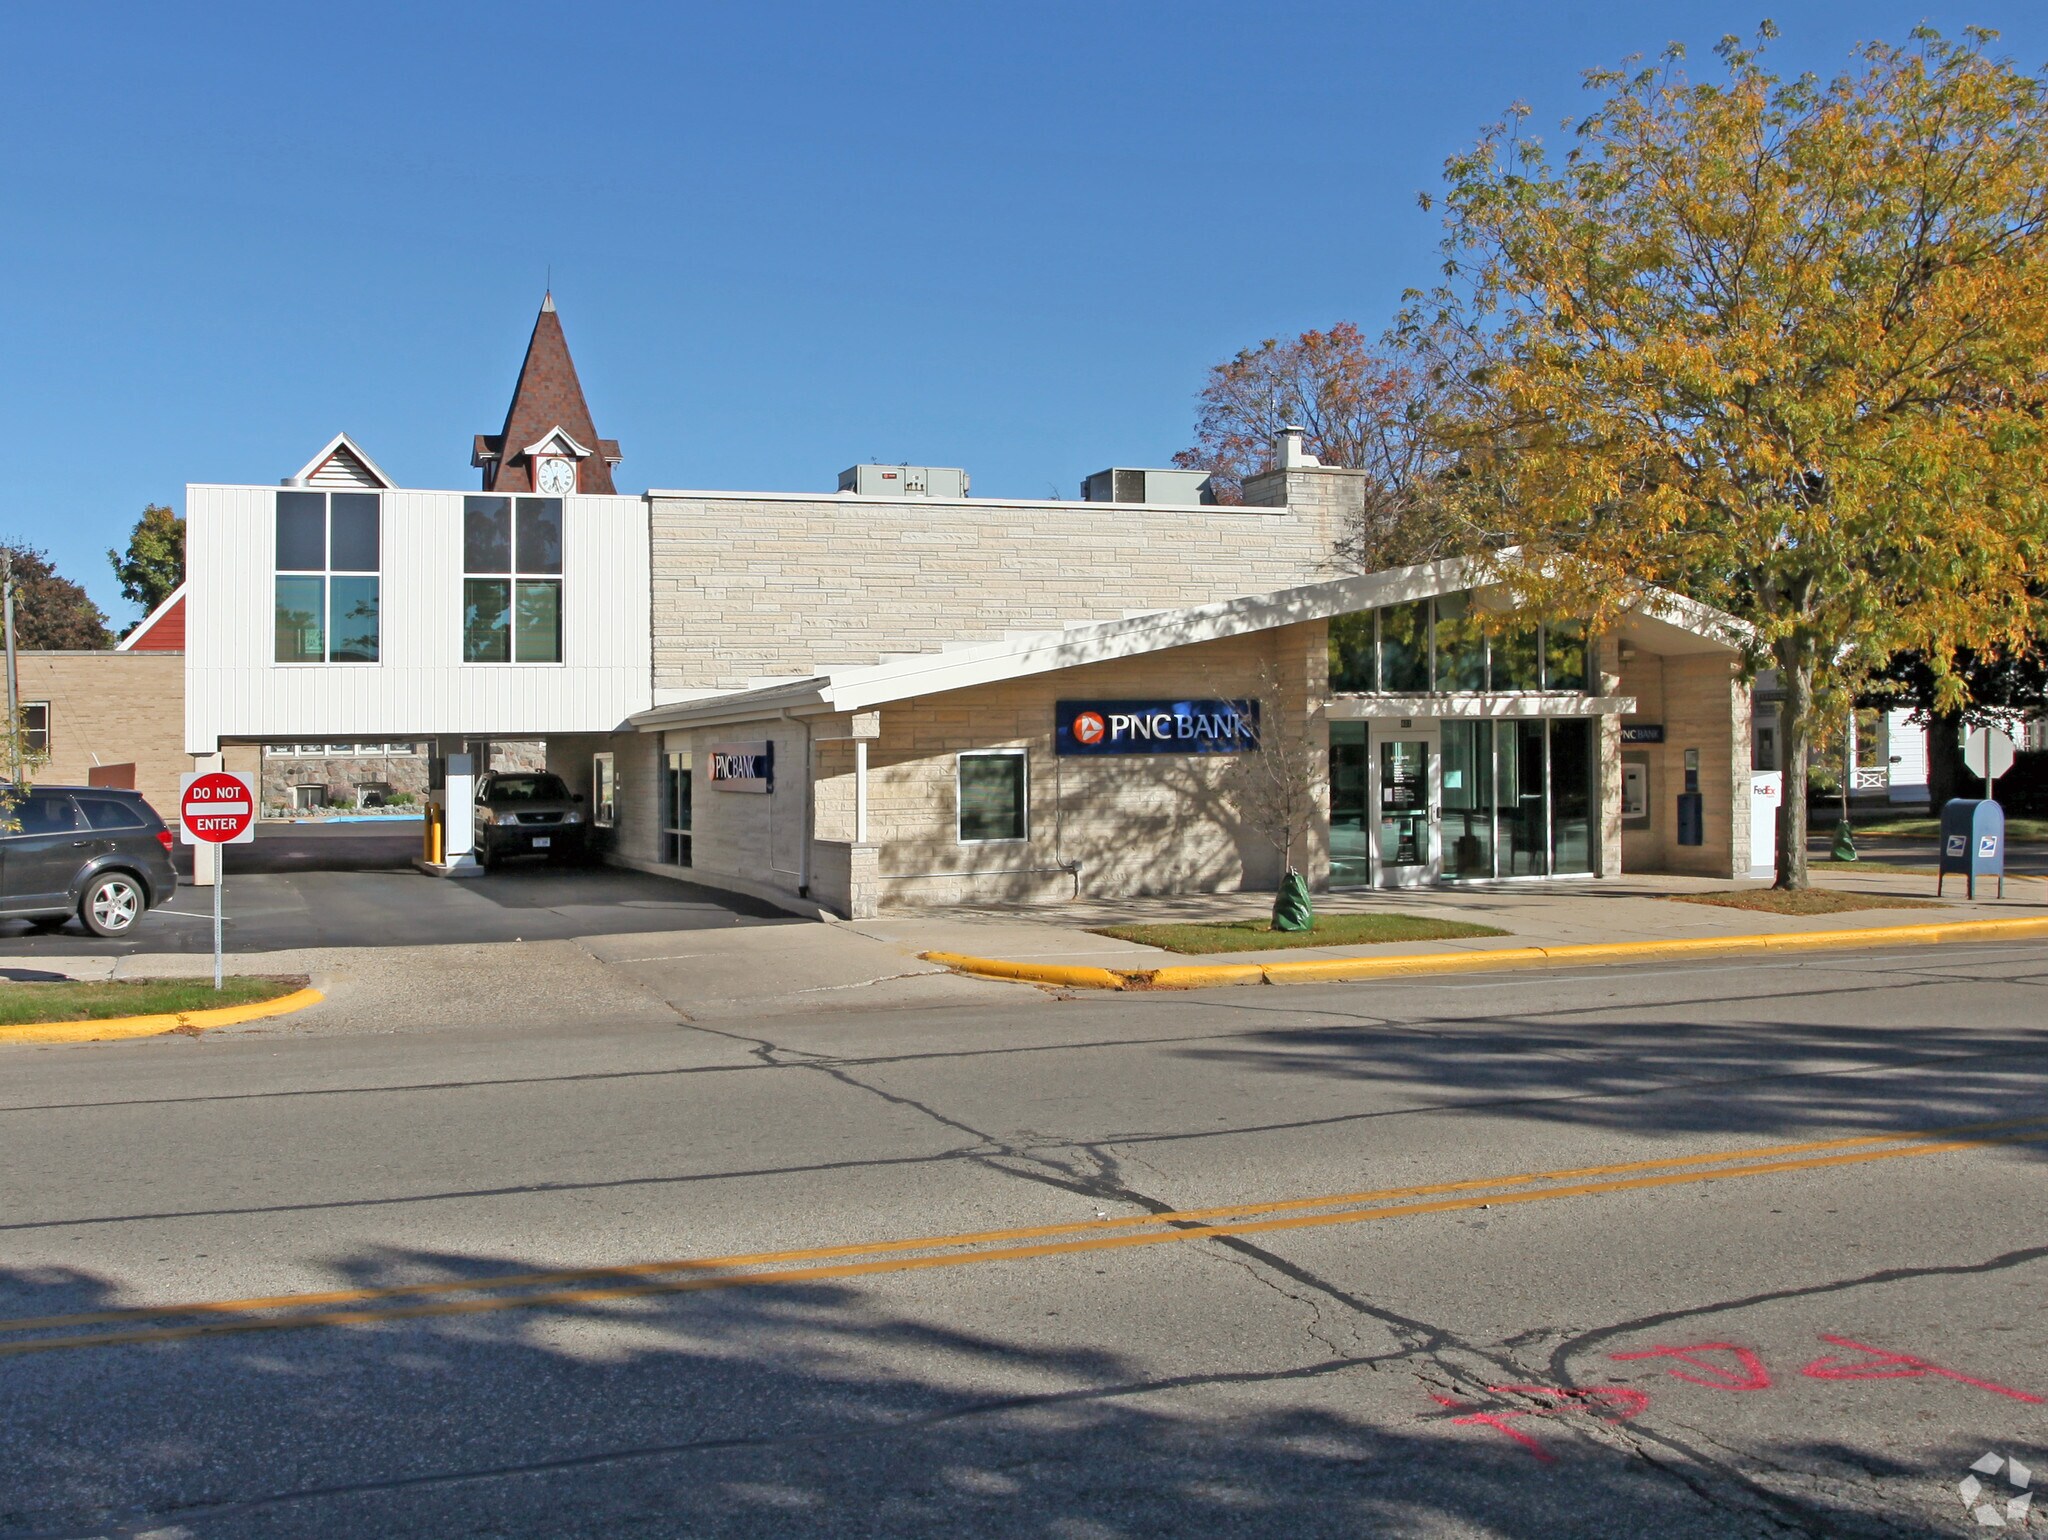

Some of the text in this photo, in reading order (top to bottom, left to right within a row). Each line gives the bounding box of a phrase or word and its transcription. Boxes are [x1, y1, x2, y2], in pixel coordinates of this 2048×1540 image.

[1108, 714, 1251, 740] PNC BANK
[1637, 729, 1659, 739] BANK
[715, 755, 756, 779] PNC BANK
[193, 786, 241, 799] DO NOT
[1753, 785, 1776, 795] FedEx
[197, 818, 237, 831] ENTER
